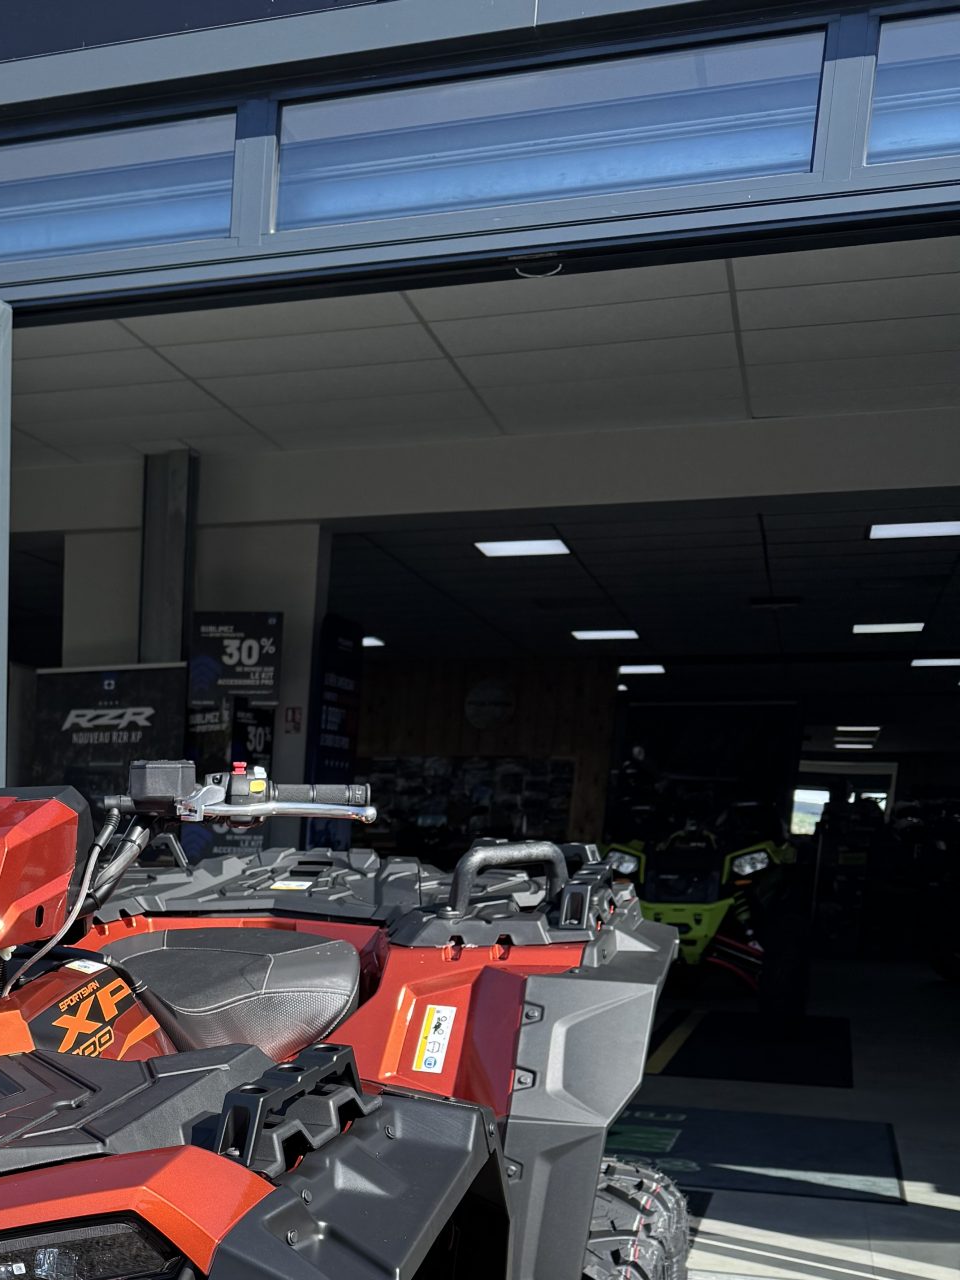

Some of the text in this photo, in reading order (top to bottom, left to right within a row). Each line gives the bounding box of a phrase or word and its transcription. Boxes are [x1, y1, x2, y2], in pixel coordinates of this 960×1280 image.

[221, 637, 276, 666] 30%
[61, 706, 156, 732] RZR
[72, 731, 111, 744] NOUVEAU
[112, 731, 129, 744] RZR
[59, 980, 100, 1013] SPORTSMAN
[51, 977, 132, 1054] XP
